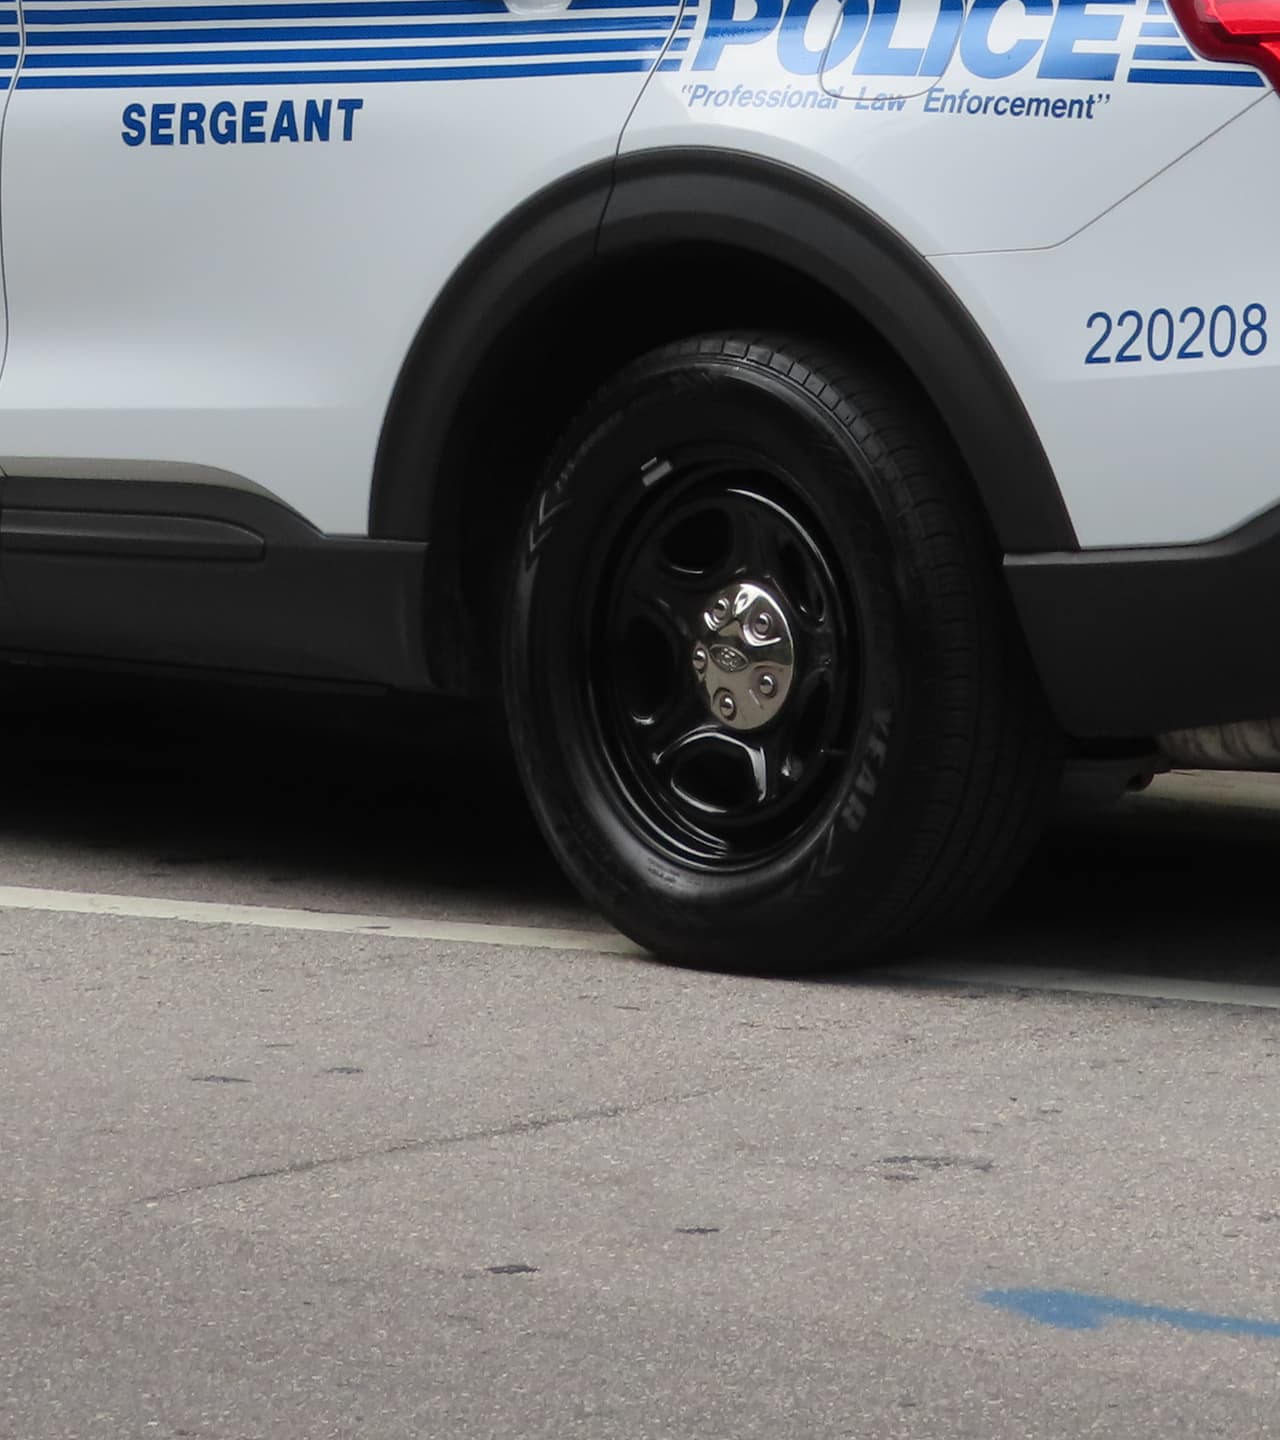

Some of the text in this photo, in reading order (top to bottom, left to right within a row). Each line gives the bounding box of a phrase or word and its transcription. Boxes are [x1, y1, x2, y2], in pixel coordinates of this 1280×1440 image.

[121, 98, 364, 147] SERGEANT
[854, 87, 907, 112] Law
[1084, 302, 1269, 365] 220208
